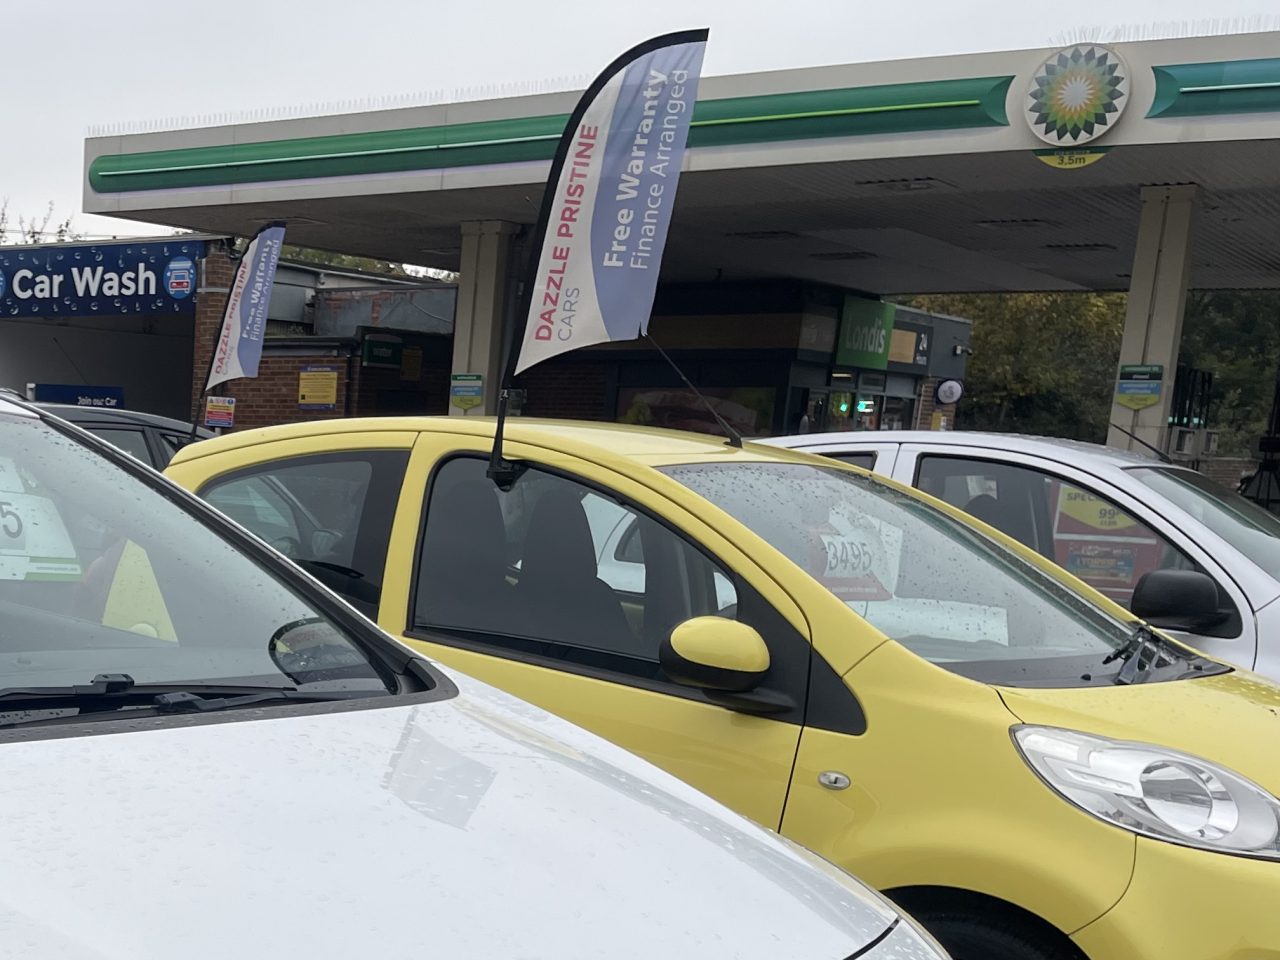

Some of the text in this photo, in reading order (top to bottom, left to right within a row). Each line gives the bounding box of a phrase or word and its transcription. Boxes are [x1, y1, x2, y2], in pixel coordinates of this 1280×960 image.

[603, 69, 668, 267] Free Warranty
[630, 70, 688, 269] Finance Arranged
[534, 124, 599, 341] DAZZLE PRISTINE
[12, 262, 156, 299] Car Wash
[251, 240, 273, 303] Warranty
[557, 287, 580, 342] CARS
[845, 316, 886, 354] Londis
[215, 322, 232, 374] DAZZLE
